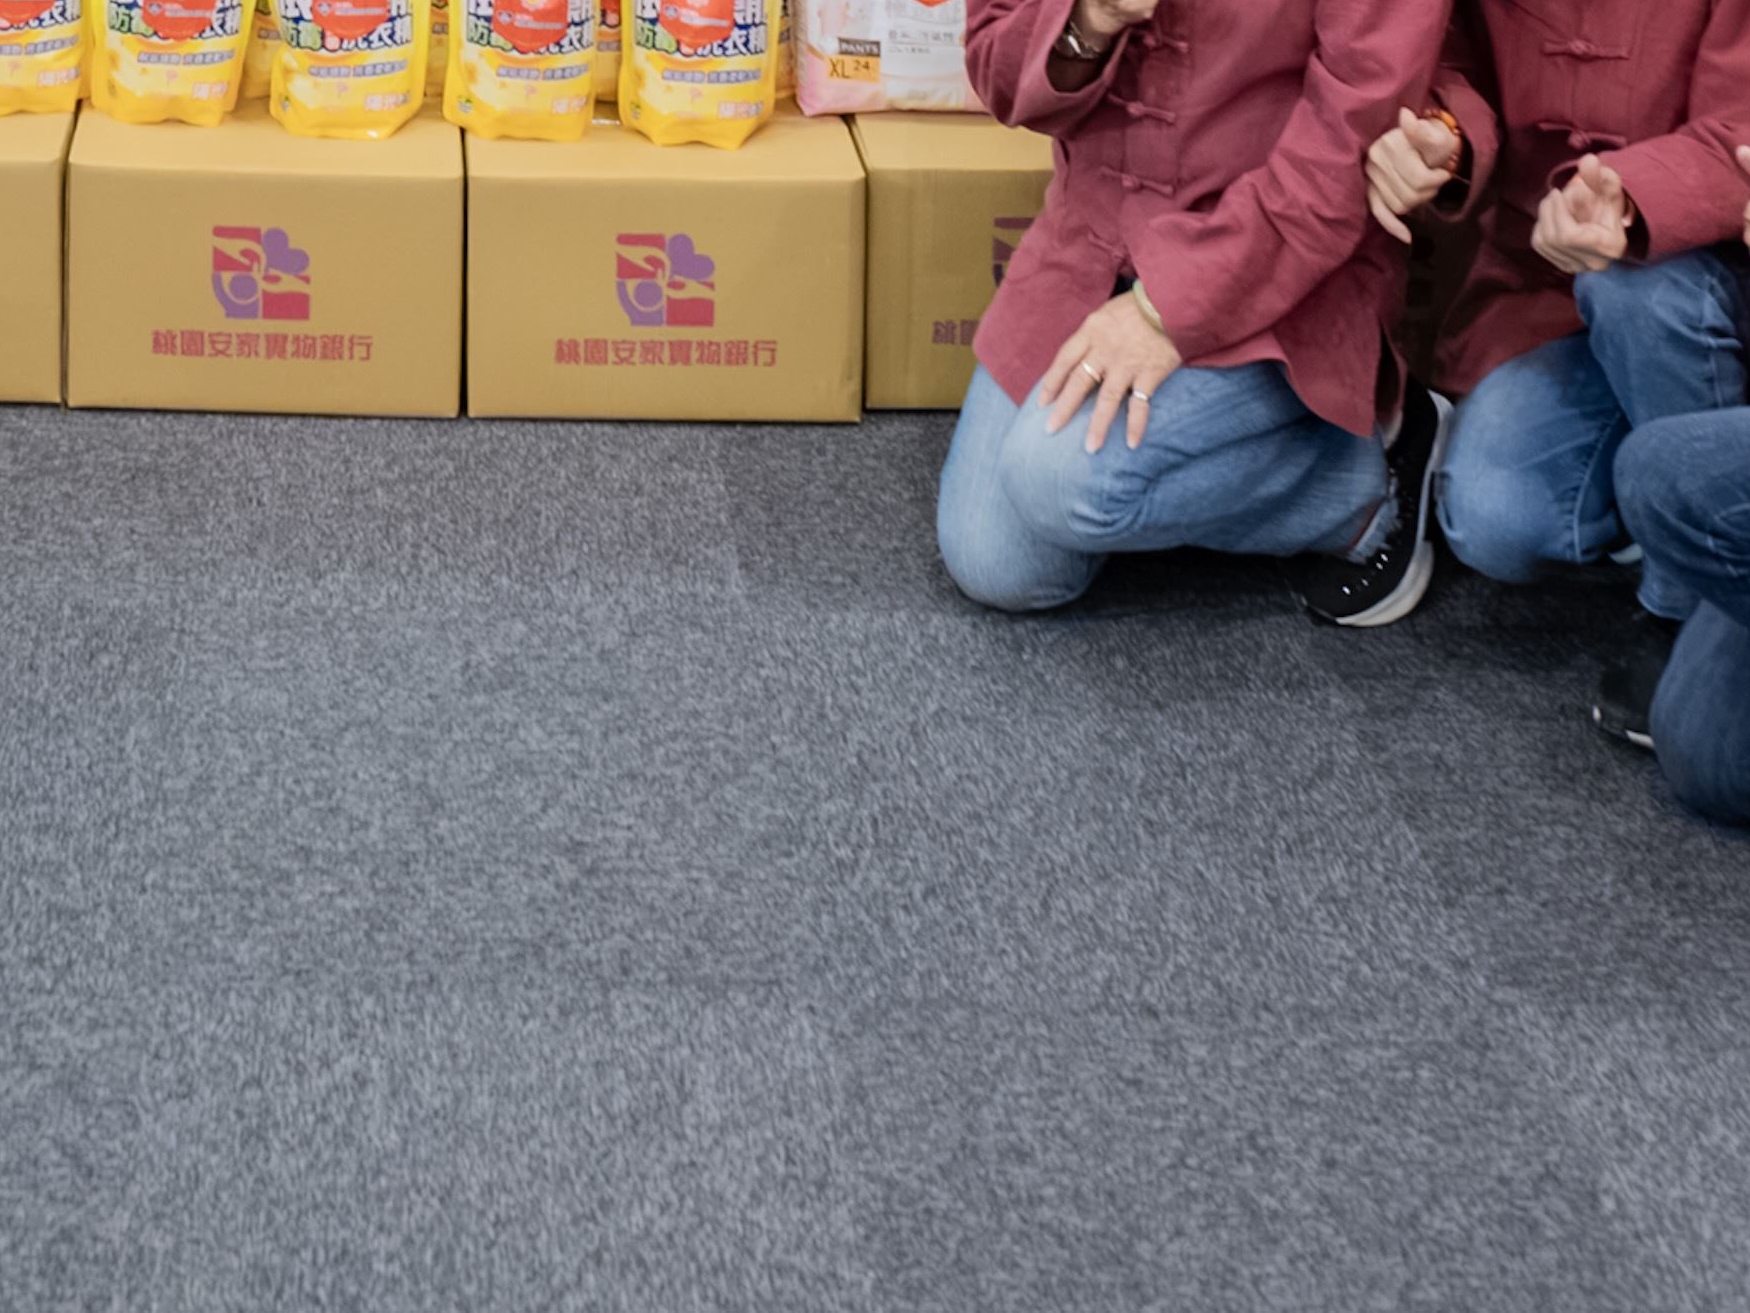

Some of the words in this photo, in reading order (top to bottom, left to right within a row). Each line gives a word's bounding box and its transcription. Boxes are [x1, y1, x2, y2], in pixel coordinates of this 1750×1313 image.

[828, 57, 850, 79] XL
[853, 60, 871, 73] 24
[151, 328, 373, 362] 桃園安家實物銀行
[554, 335, 779, 369] 桃園安家實物銀行
